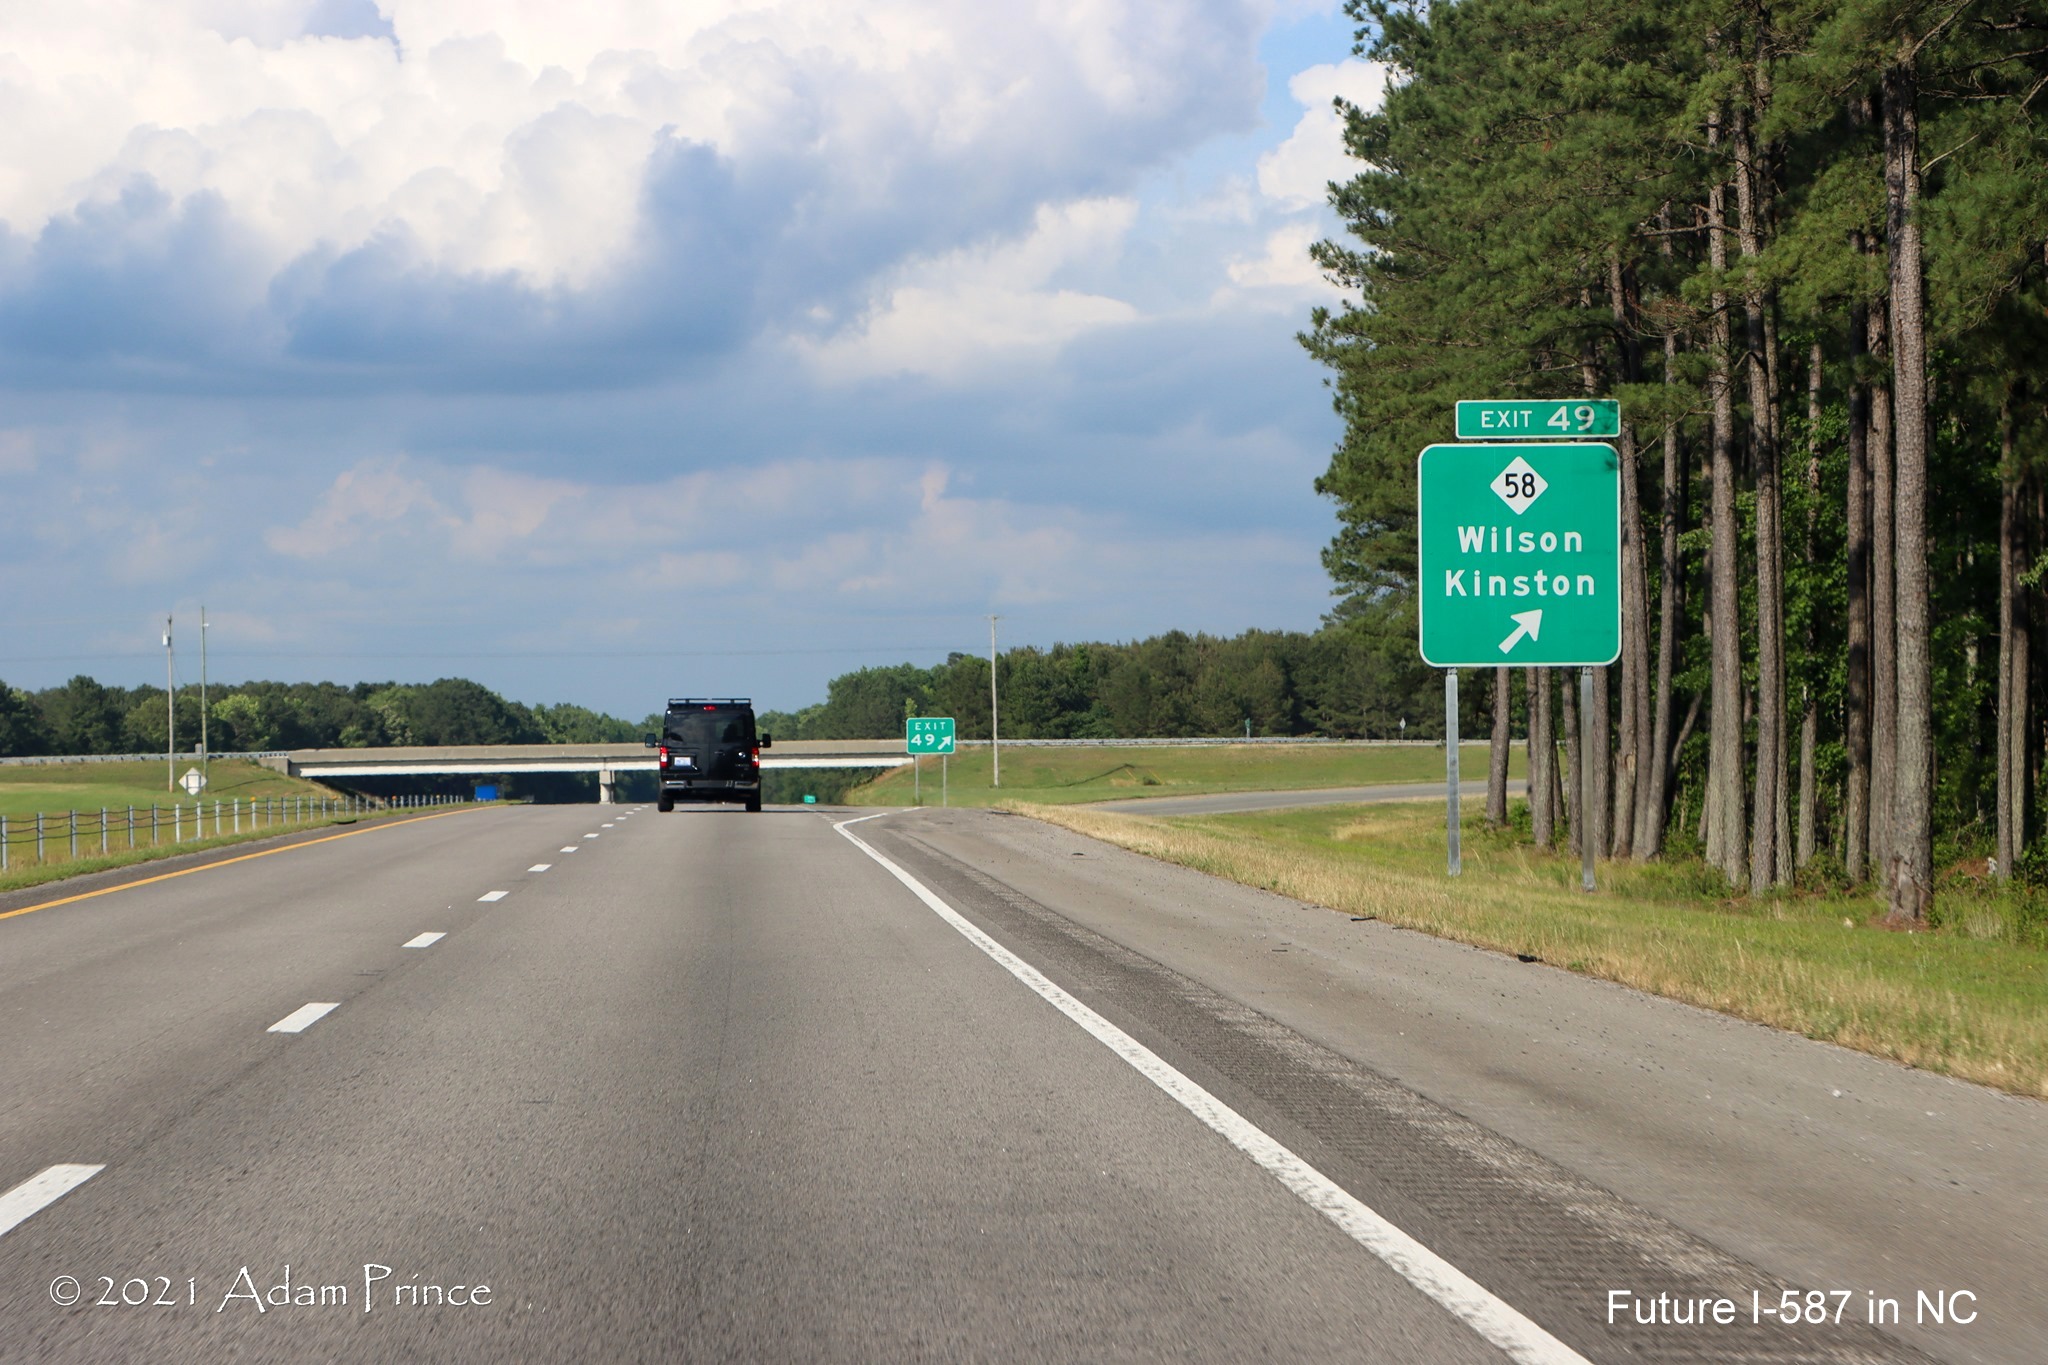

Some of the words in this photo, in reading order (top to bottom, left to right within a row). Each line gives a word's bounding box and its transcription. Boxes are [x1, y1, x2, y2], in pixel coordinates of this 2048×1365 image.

[1481, 410, 1532, 428] EXIT
[1547, 405, 1595, 431] 49
[1505, 472, 1536, 498] 58
[1457, 526, 1582, 553] Wilson
[1445, 569, 1595, 597] Kinston
[915, 722, 946, 731] EXIT
[911, 734, 935, 746] 49
